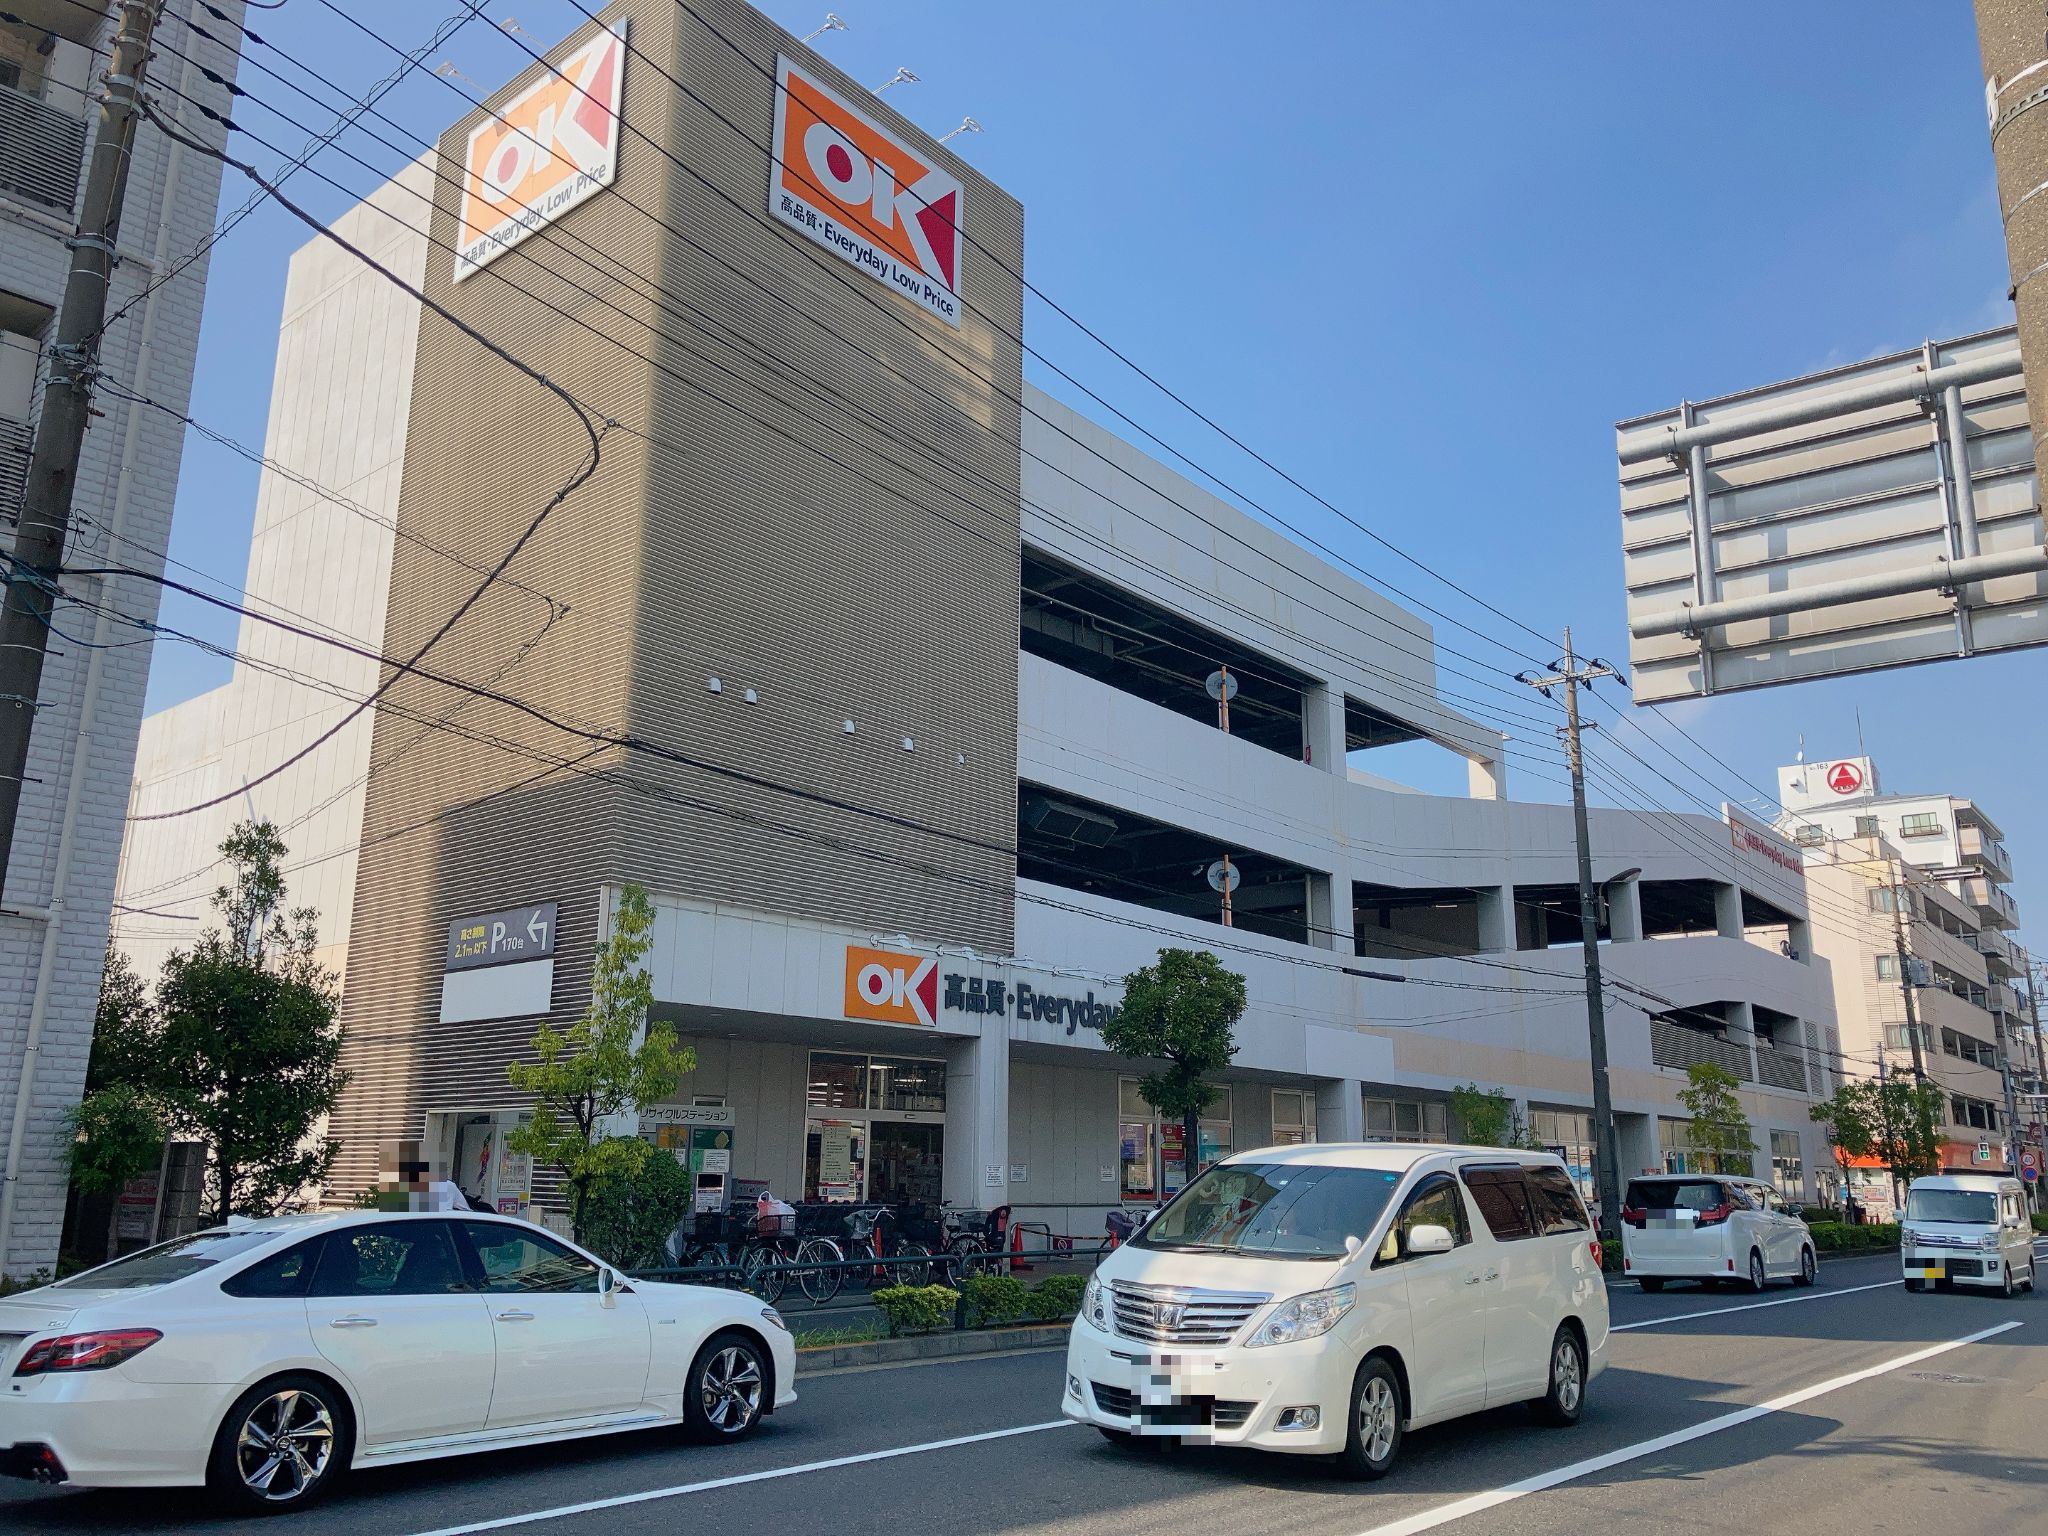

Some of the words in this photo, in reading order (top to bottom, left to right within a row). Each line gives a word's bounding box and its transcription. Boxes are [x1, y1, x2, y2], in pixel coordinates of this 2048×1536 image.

[481, 38, 615, 204] OK
[547, 184, 573, 212] Low
[576, 163, 606, 194] Price
[803, 122, 958, 292] OK
[892, 264, 920, 295] Low
[924, 284, 954, 317] Price
[490, 921, 506, 954] P
[502, 937, 524, 952] 170台
[857, 959, 938, 1027] OK
[640, 1109, 728, 1121] リサイクルステーション
